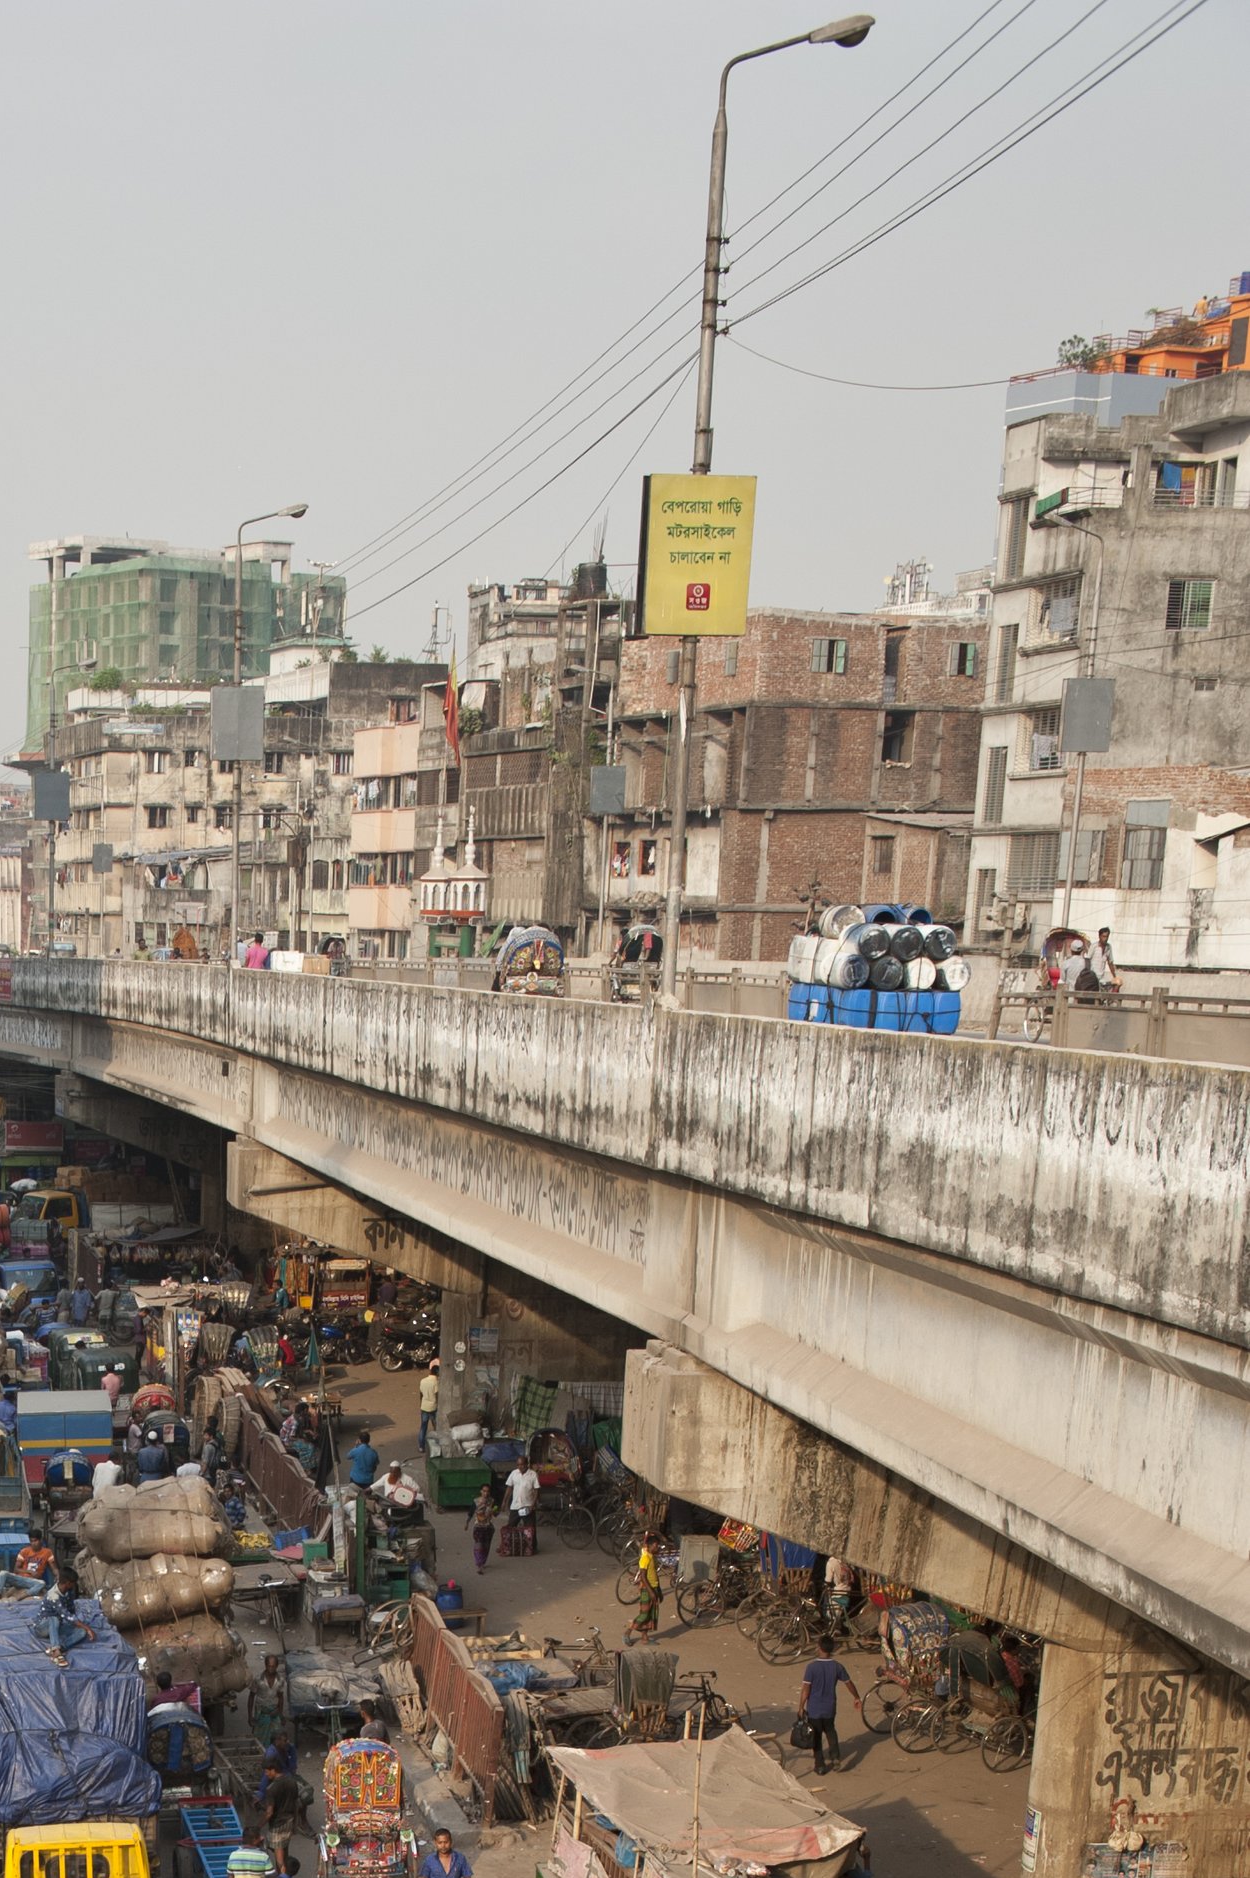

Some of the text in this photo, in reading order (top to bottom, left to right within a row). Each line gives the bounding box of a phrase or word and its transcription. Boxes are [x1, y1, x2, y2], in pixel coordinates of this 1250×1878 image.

[661, 497, 743, 517] বেপরোয়া গাড়ি
[666, 523, 737, 540] মটরসাইকেল
[669, 551, 732, 565] চালাবেন না
